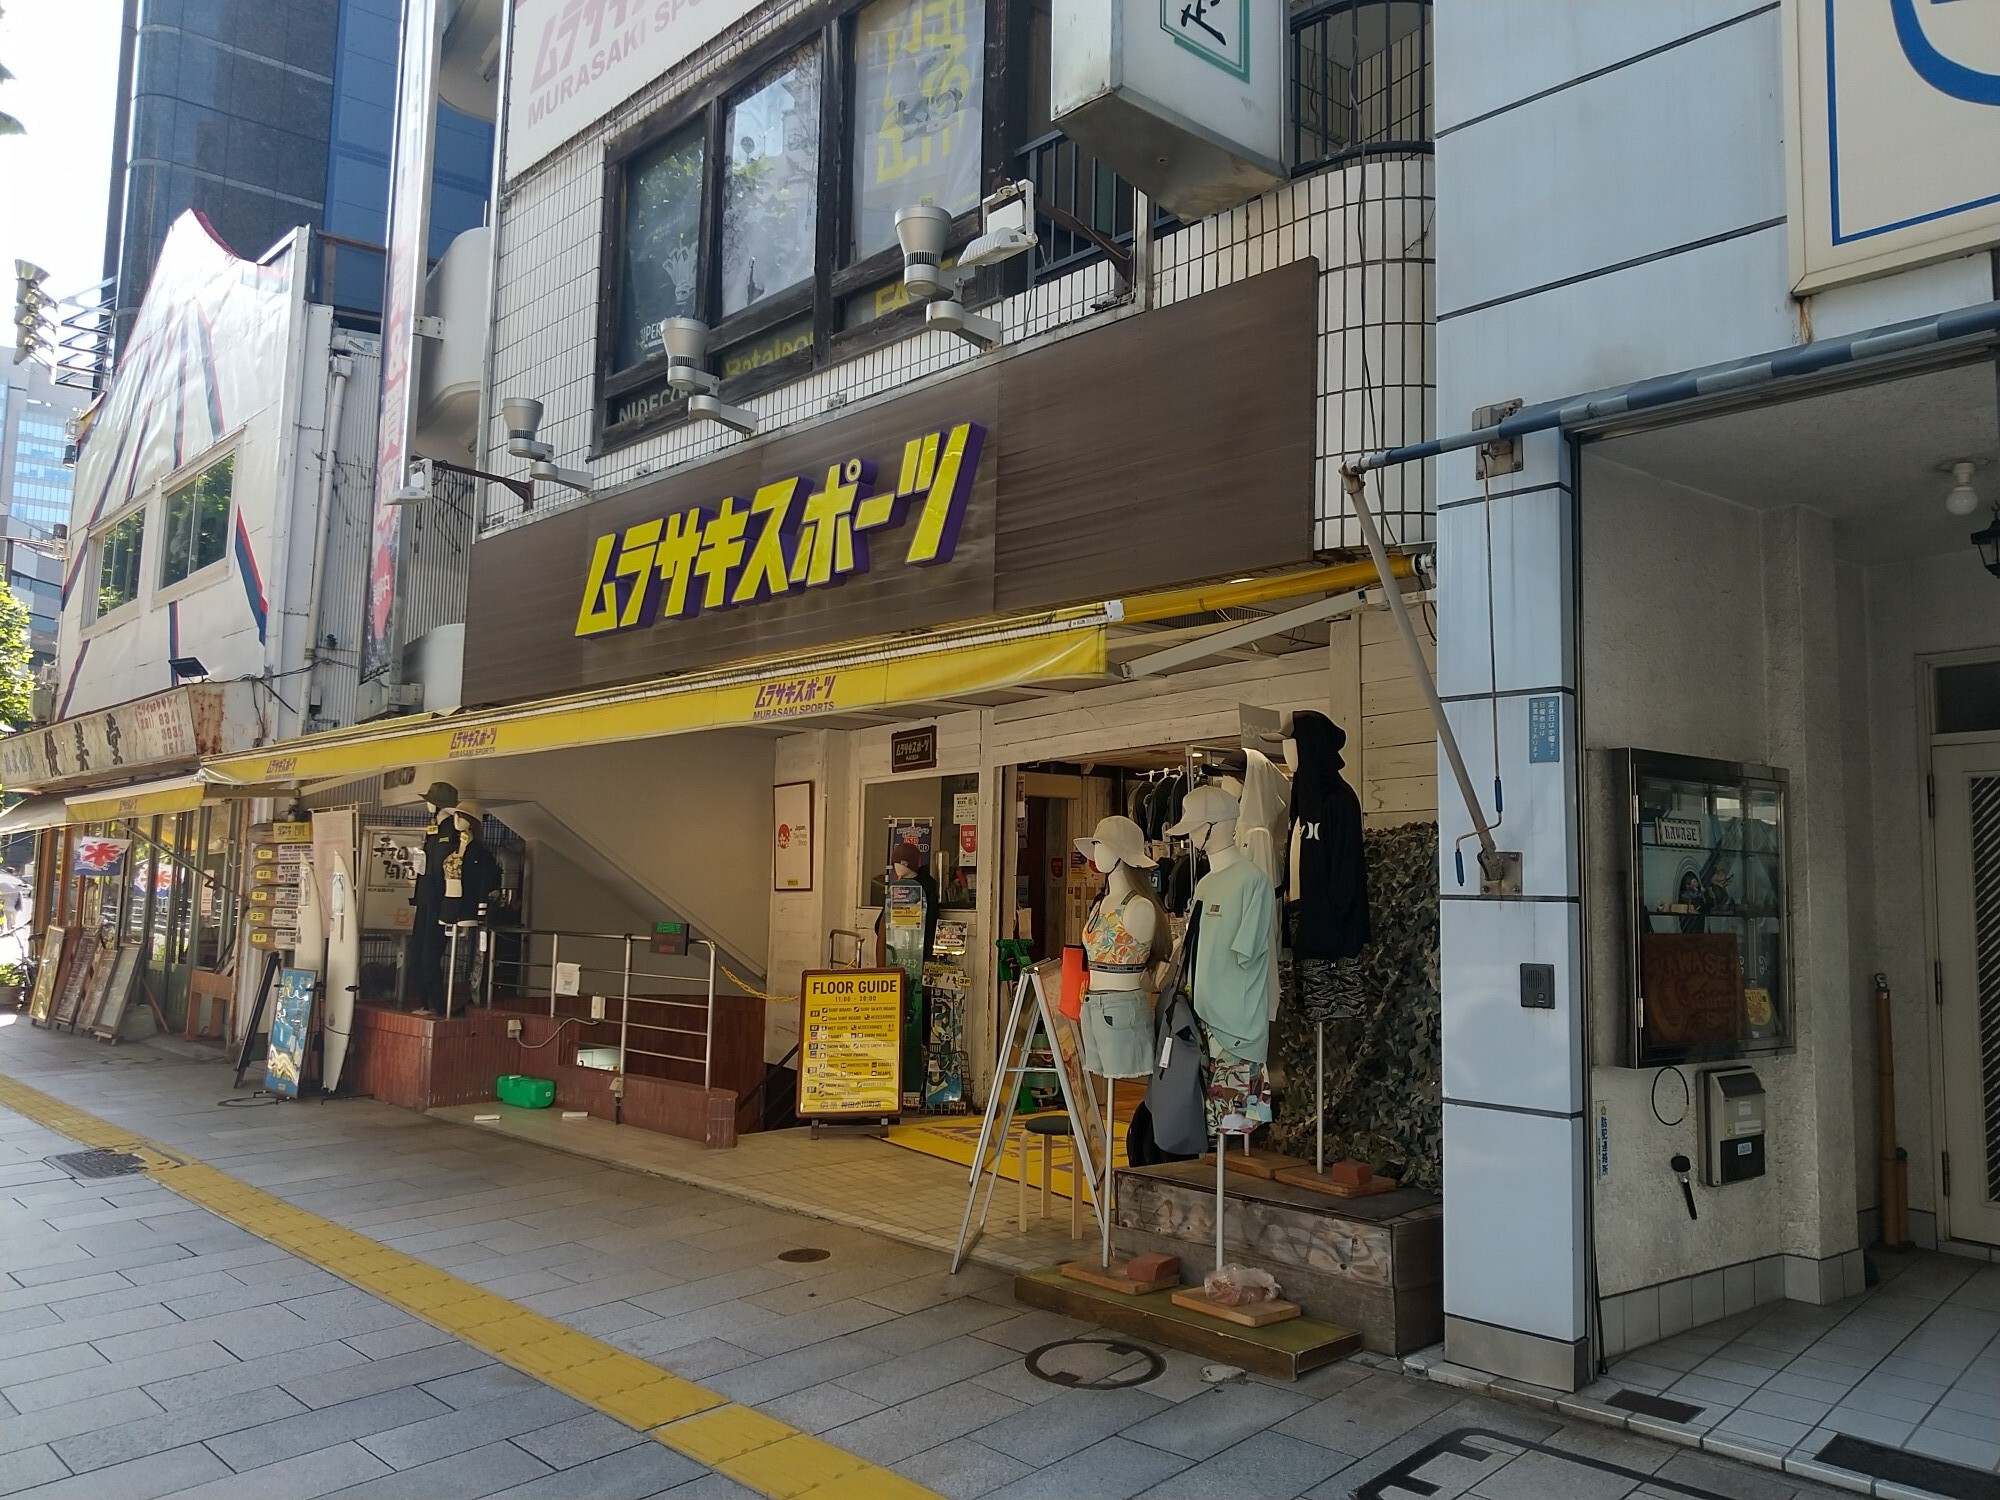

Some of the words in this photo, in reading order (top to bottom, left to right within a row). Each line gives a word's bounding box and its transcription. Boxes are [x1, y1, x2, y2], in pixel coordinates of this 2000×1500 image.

[527, 16, 647, 129] MURASAKI
[574, 422, 980, 638] ムラサキスポーツ
[754, 675, 837, 709] ムラサキスポーツ
[752, 705, 798, 721] MURASAKI
[799, 701, 836, 714] SPORTS
[450, 727, 498, 750] ムラサキスポーツ
[896, 738, 930, 756] ムラサキスポーツ
[1664, 826, 1697, 841] KAWASE
[812, 981, 854, 995] FLOOR
[858, 980, 897, 993] GUIDE
